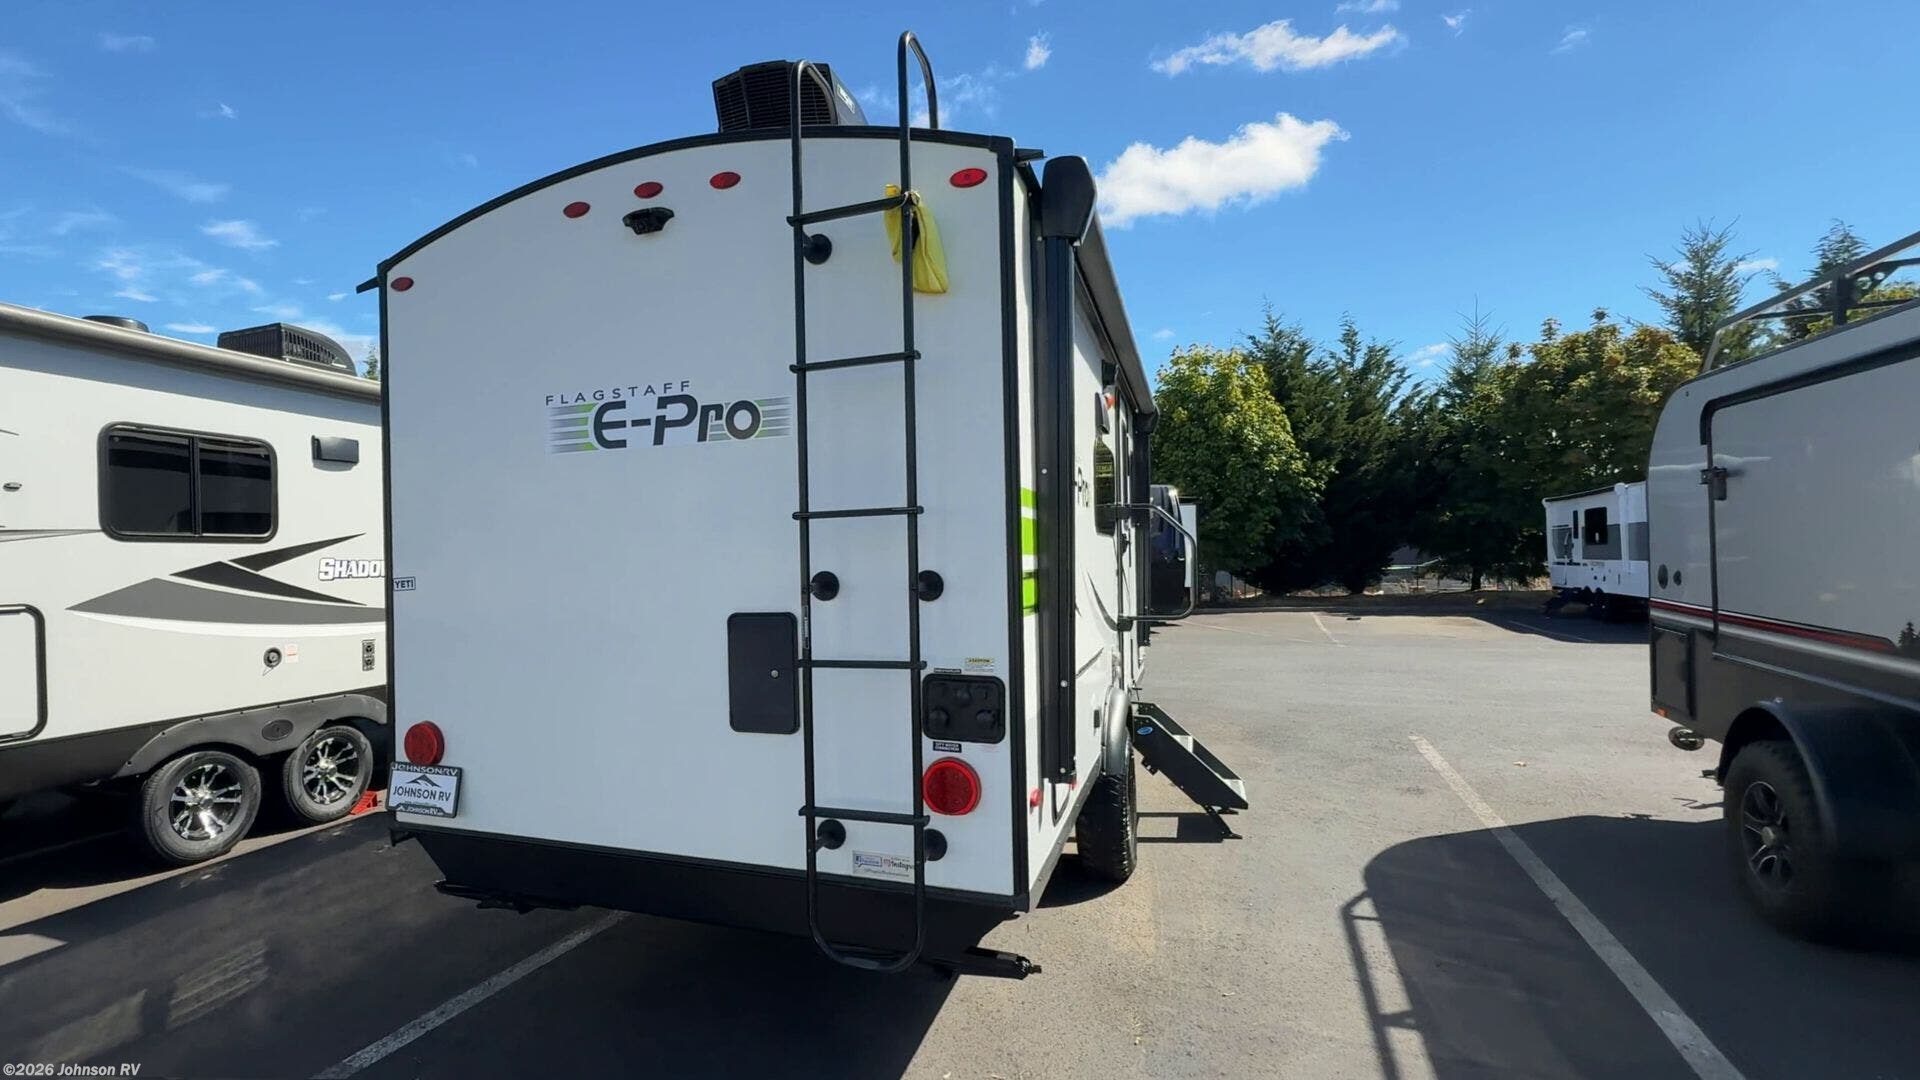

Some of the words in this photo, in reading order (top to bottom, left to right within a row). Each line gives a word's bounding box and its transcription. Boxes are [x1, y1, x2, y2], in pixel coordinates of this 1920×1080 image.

[545, 380, 692, 406] FLAGSTAFF
[593, 395, 762, 449] E-Pro
[319, 557, 386, 581] SHADO
[394, 580, 415, 588] YETI
[393, 786, 437, 800] JOHNSON
[439, 791, 451, 801] RV
